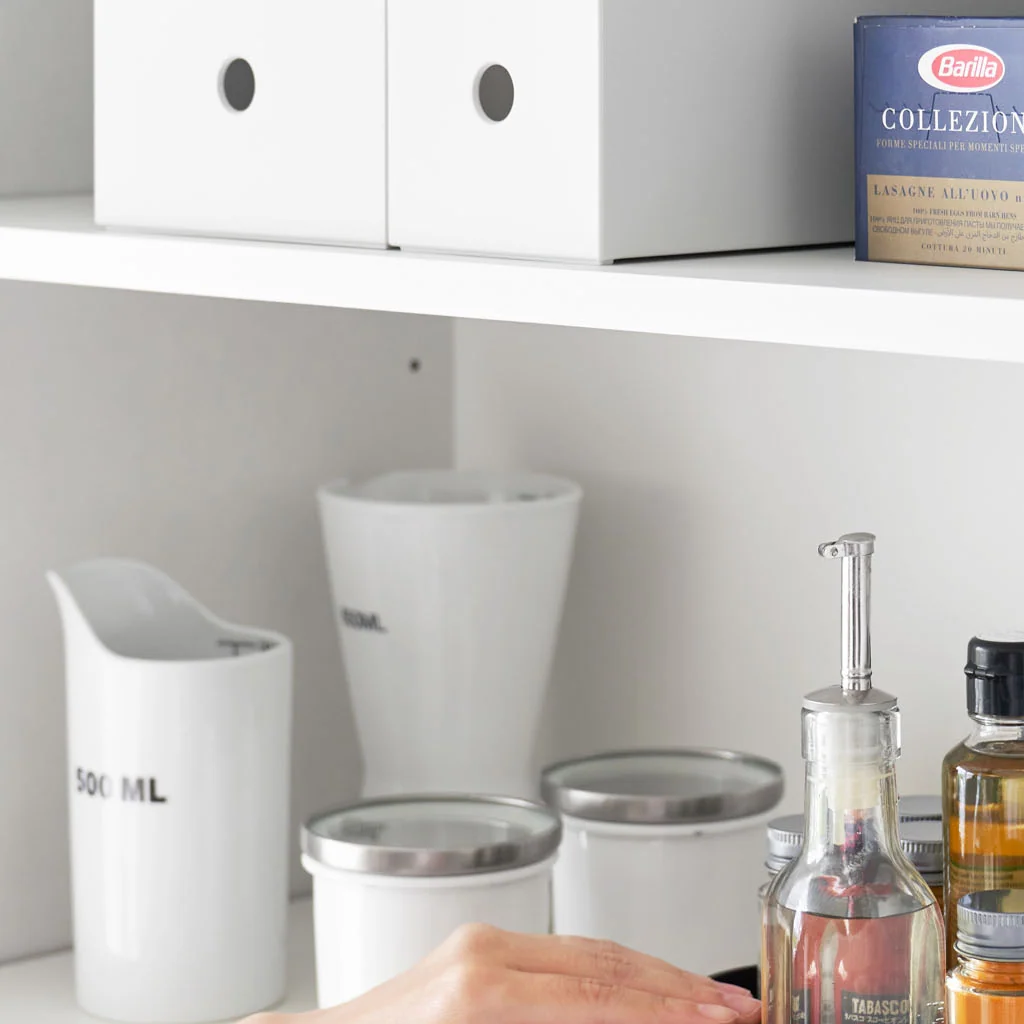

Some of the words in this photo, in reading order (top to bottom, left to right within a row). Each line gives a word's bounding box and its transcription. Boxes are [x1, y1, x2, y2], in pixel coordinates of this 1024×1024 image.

[938, 55, 998, 78] Barilla
[876, 138, 906, 149] FORME
[907, 139, 947, 150] SPECIALI
[949, 141, 965, 151] PER
[968, 142, 1008, 153] MOMENTI
[874, 184, 936, 199] LASAGNE
[921, 242, 959, 252] COTTURA
[962, 245, 973, 253] 20
[976, 246, 1007, 256] MINUTI
[121, 776, 167, 803] ML
[851, 997, 909, 1016] TABASCO
